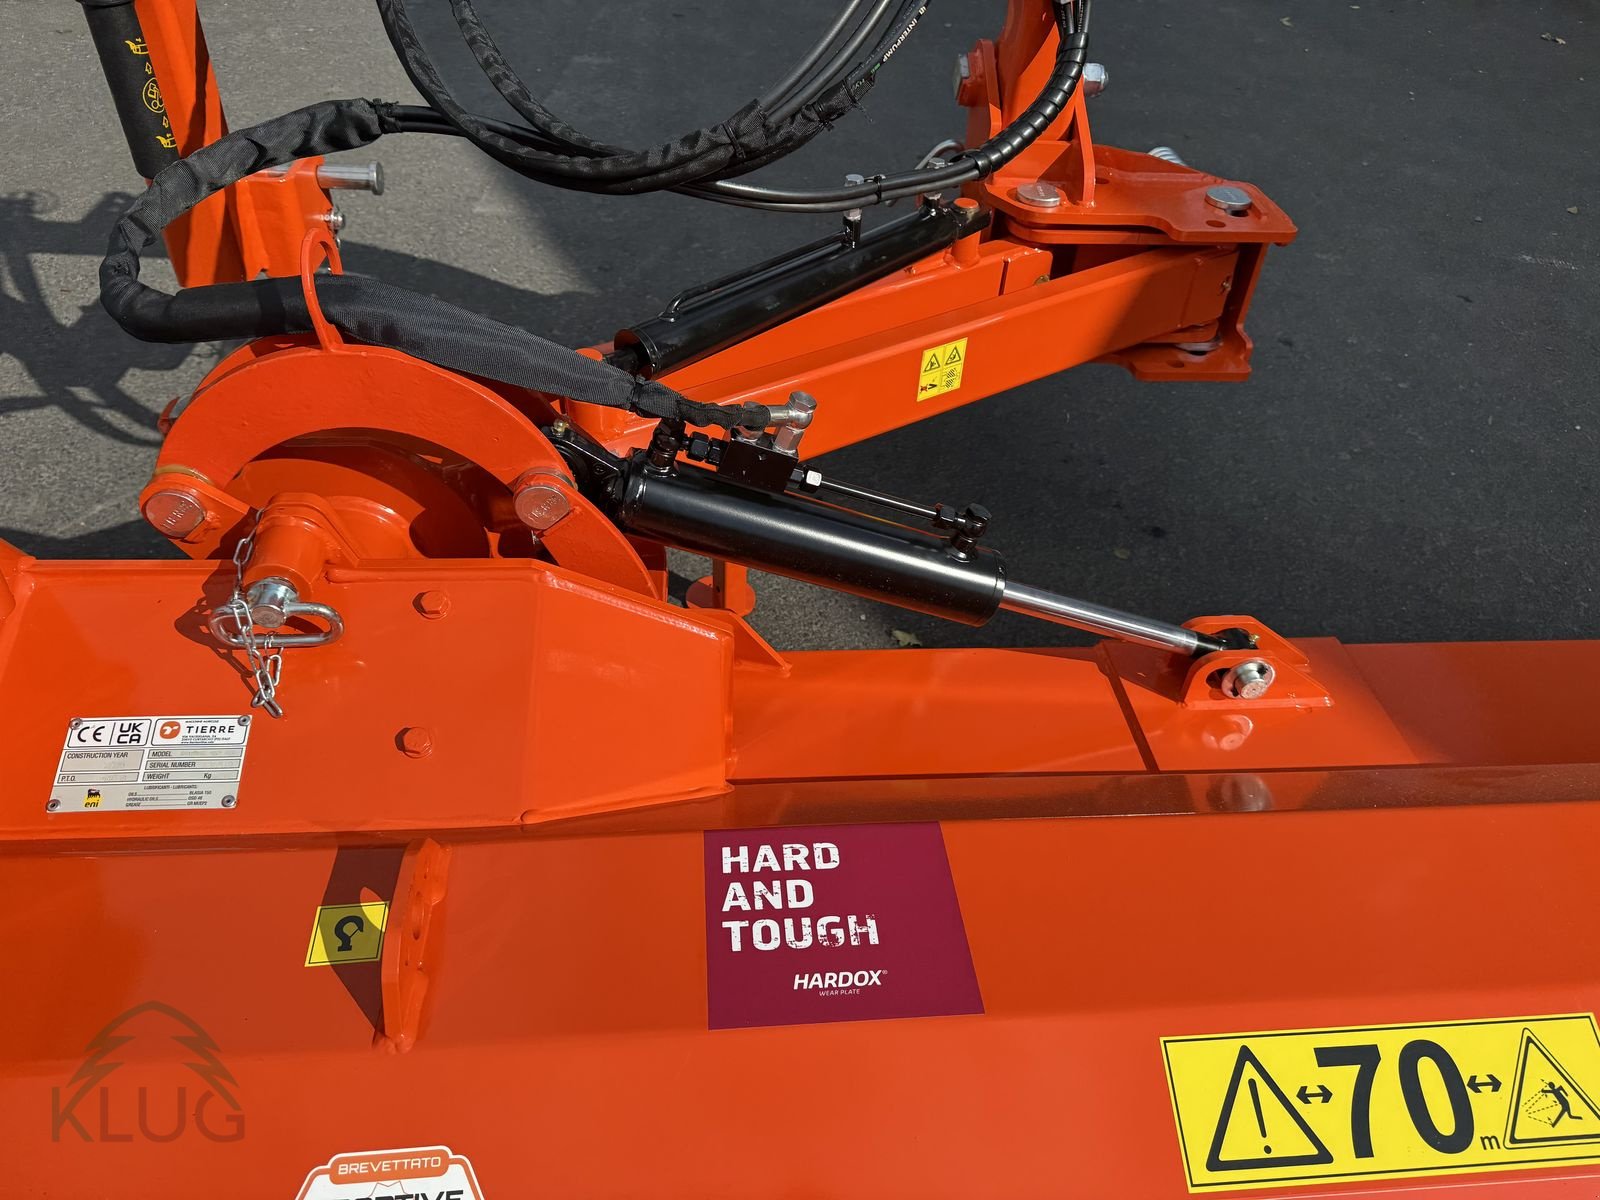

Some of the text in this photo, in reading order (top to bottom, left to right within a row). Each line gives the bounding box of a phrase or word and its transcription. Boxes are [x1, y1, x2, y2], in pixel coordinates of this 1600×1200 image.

[883, 18, 918, 62] INTERPUMP
[119, 722, 144, 733] UK
[186, 725, 236, 734] TIERRE
[77, 725, 106, 743] CE
[116, 733, 142, 744] CA
[66, 752, 112, 760] CONSTRUCTION
[149, 761, 169, 769] SERIAL
[203, 772, 212, 780] Kg
[84, 800, 99, 808] eni
[721, 841, 840, 874] HARD
[721, 879, 815, 912] AND
[721, 914, 880, 952] TOUGH
[819, 989, 839, 997] WEAR
[1313, 1038, 1501, 1159] 70 m
[338, 1156, 442, 1175] BREVETTATO
